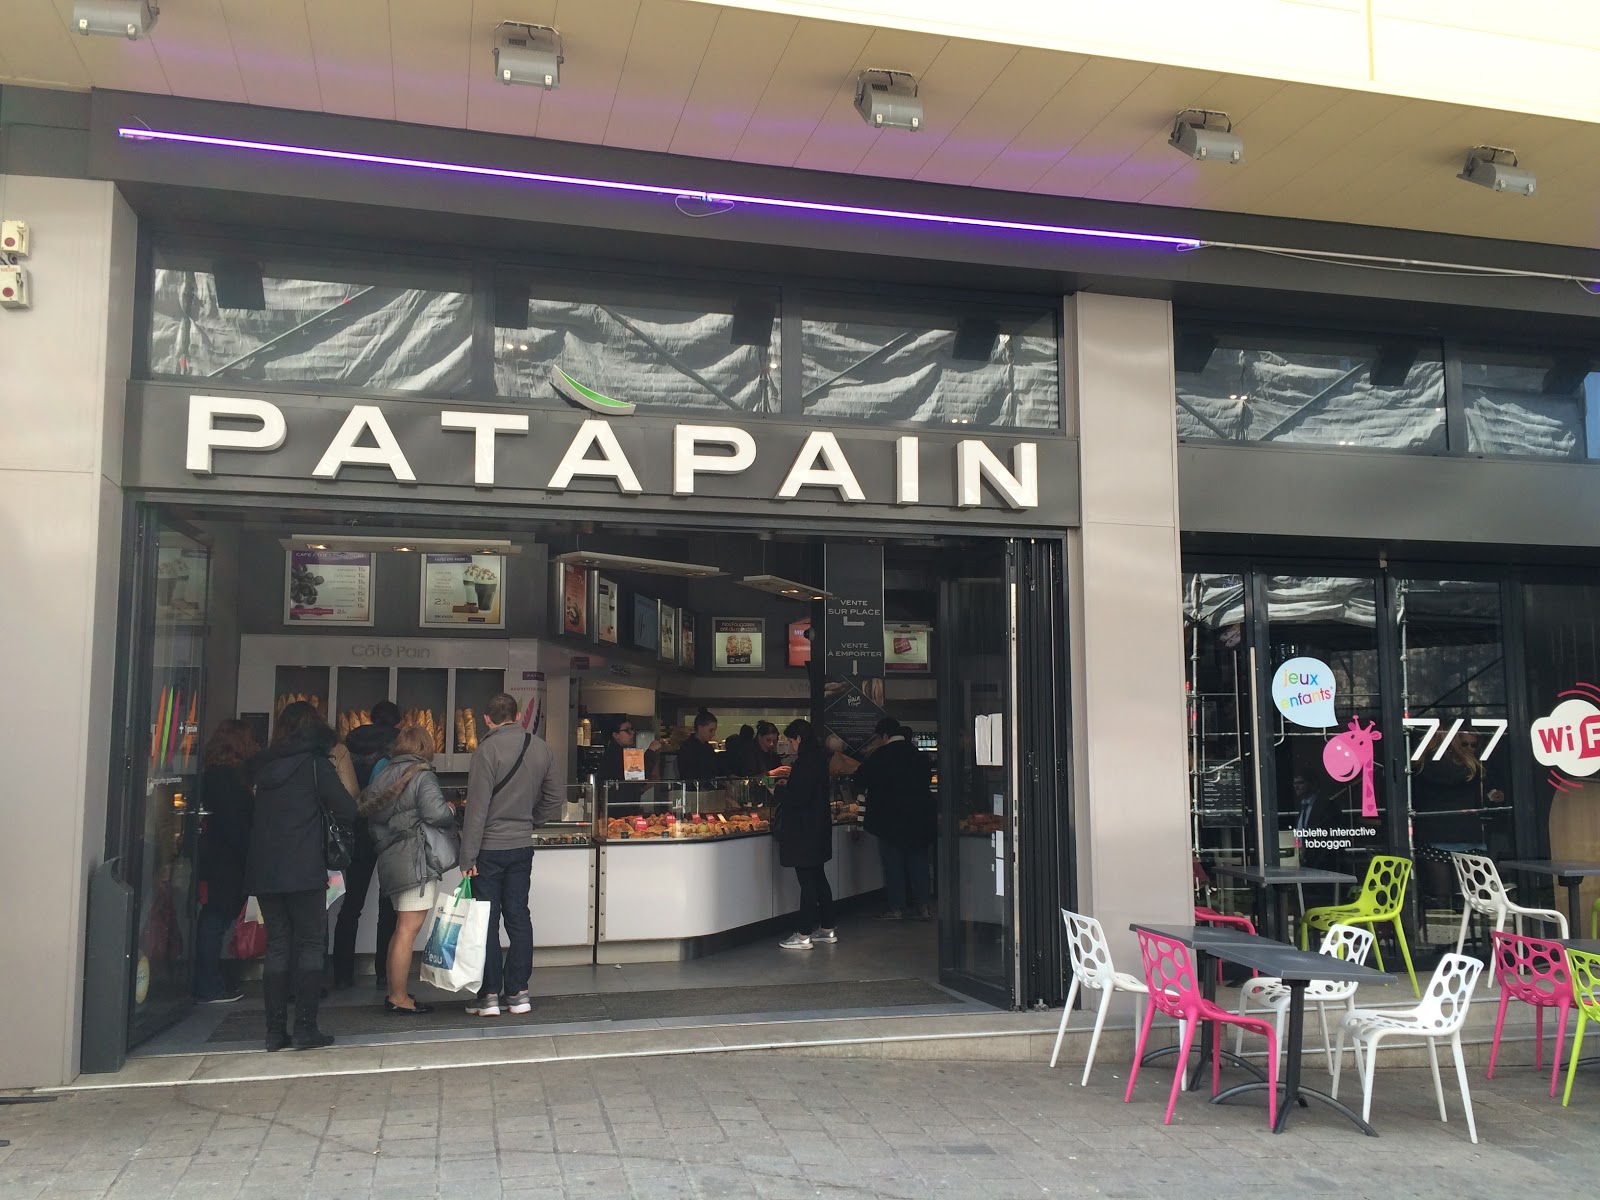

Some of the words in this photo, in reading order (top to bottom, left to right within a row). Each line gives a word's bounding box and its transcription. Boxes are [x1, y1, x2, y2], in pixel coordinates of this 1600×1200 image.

[186, 395, 1038, 510] PATAPAIN
[850, 608, 881, 616] PLACE
[351, 643, 393, 658] Côté
[397, 644, 431, 658] Pain
[1284, 669, 1319, 688] jeux
[1402, 718, 1508, 761] 7/7
[1329, 827, 1376, 837] interactive
[1304, 838, 1352, 850] toboggan
